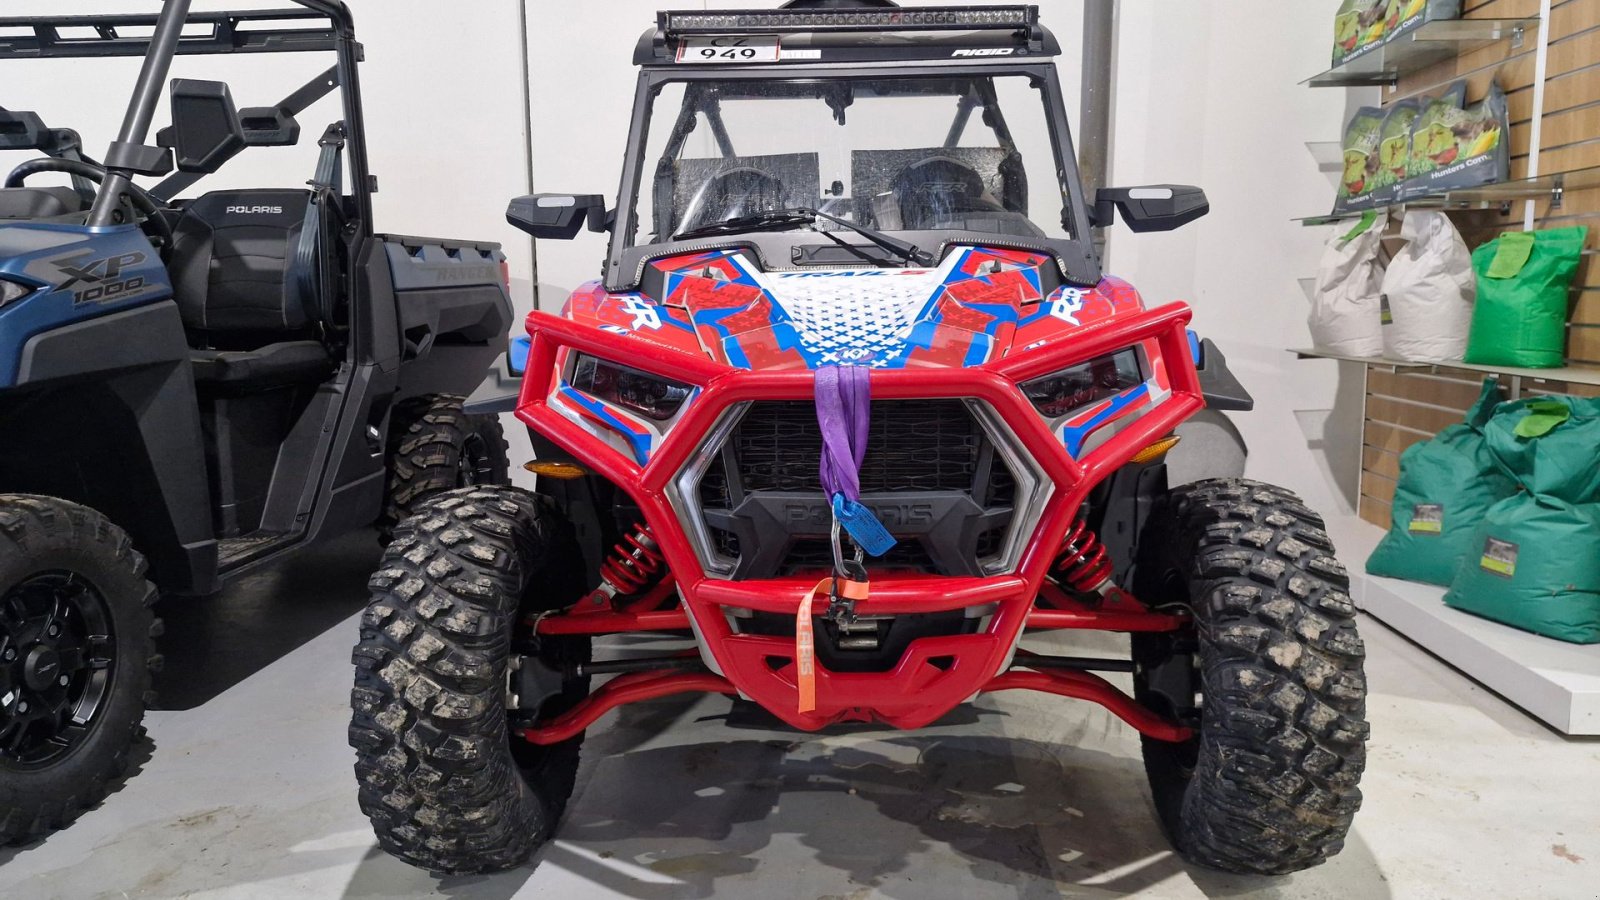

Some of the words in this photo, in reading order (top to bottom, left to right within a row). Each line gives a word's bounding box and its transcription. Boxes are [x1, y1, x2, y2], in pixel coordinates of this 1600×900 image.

[710, 37, 748, 48] CZ
[700, 48, 756, 60] 949
[1431, 163, 1466, 179] Hunters
[226, 206, 283, 214] POLARIS
[52, 250, 148, 293] XP
[73, 276, 146, 304] 1000
[784, 504, 933, 526] PORIS
